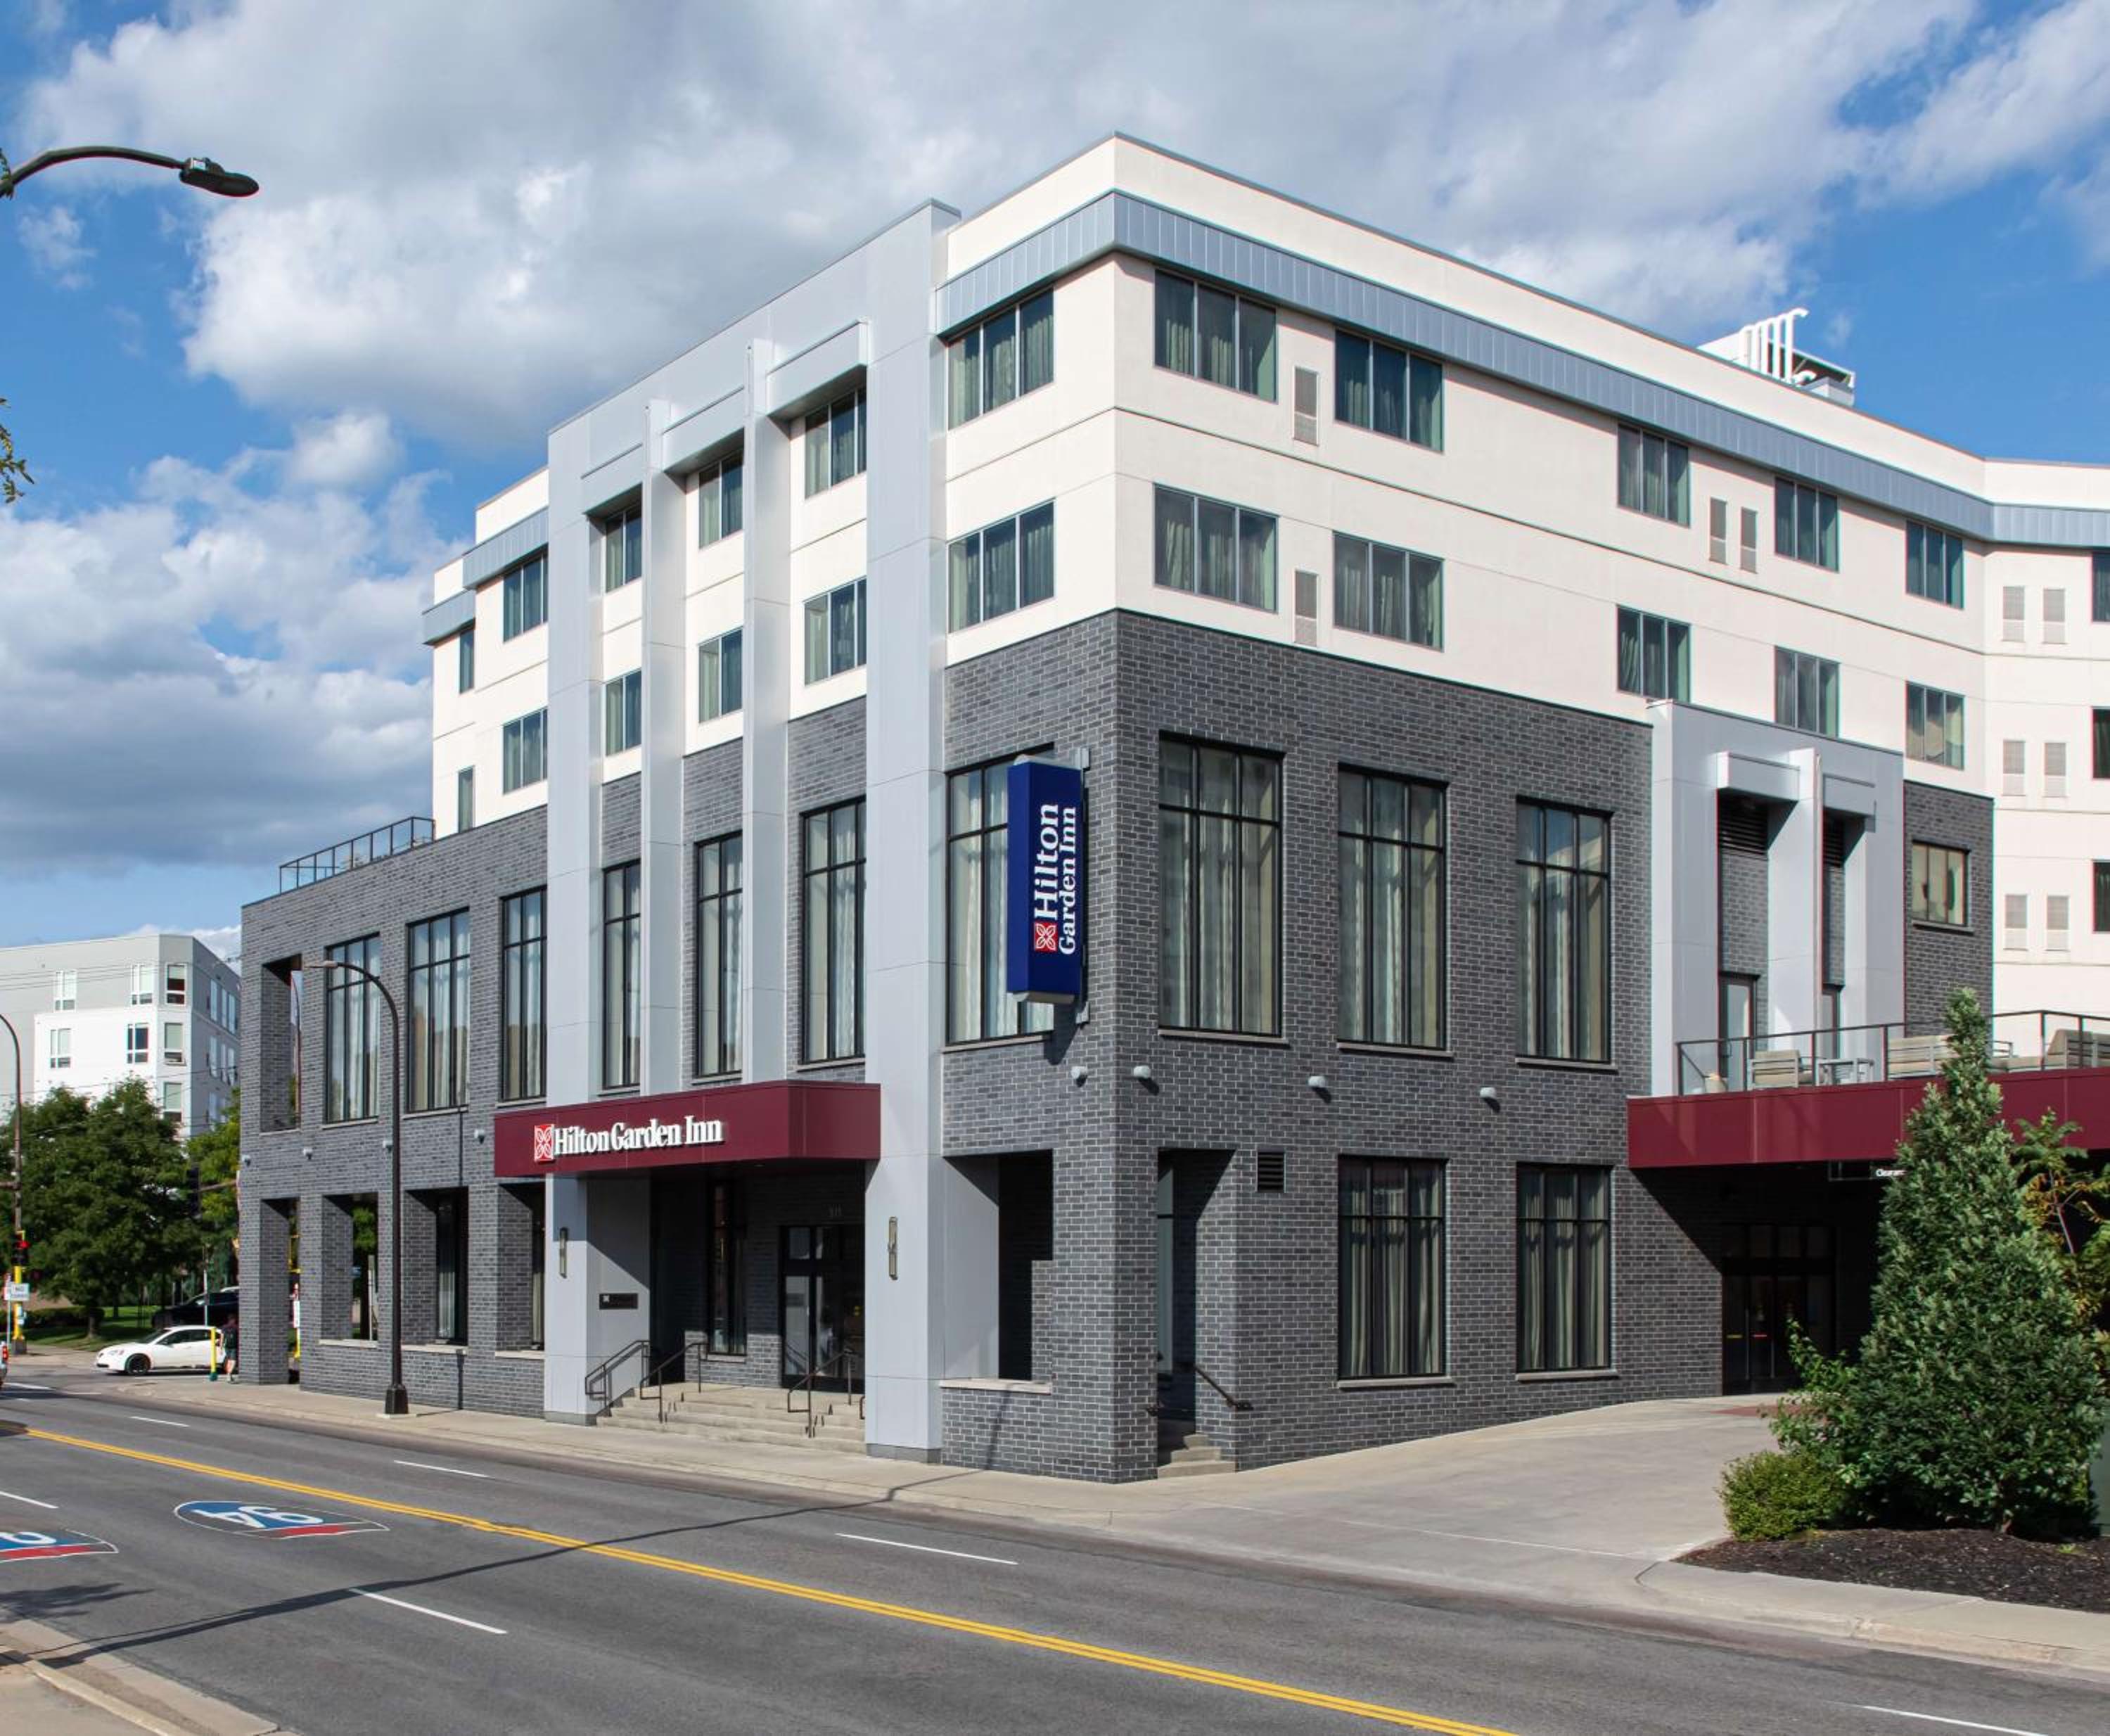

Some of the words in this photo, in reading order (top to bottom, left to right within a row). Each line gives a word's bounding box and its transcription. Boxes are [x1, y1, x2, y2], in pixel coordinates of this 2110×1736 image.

[1059, 808, 1076, 855] Inn
[1034, 803, 1059, 920] Hilton
[1059, 857, 1076, 955] Garden
[554, 1125, 610, 1155] Hilton
[610, 1118, 682, 1151] Garden
[684, 1115, 724, 1145] Inn
[191, 1505, 324, 1528] 94
